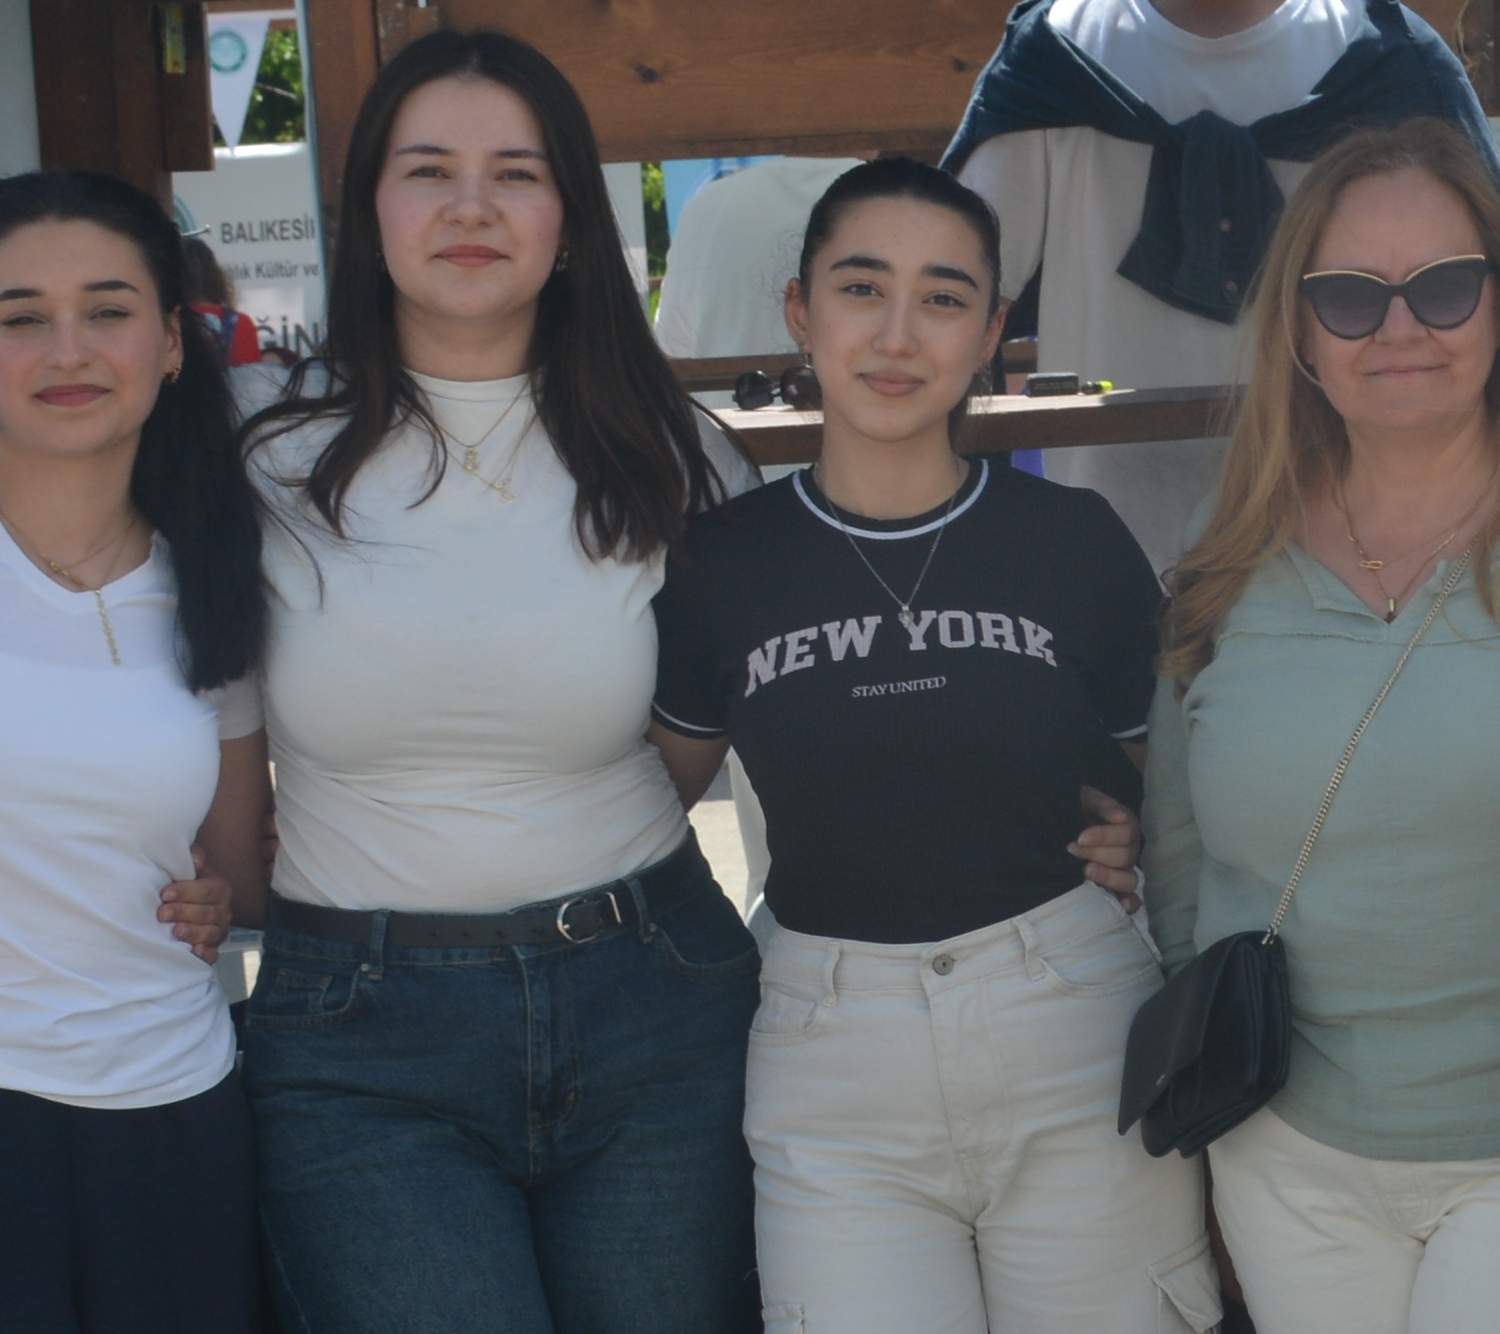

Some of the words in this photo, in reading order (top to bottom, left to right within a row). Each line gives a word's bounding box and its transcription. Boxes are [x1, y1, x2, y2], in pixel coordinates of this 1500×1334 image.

[220, 213, 315, 245] BALIKESİ
[744, 615, 882, 699] NEW
[898, 609, 1058, 668] YORK
[851, 683, 889, 698] STAY
[889, 675, 947, 695] UNITED
